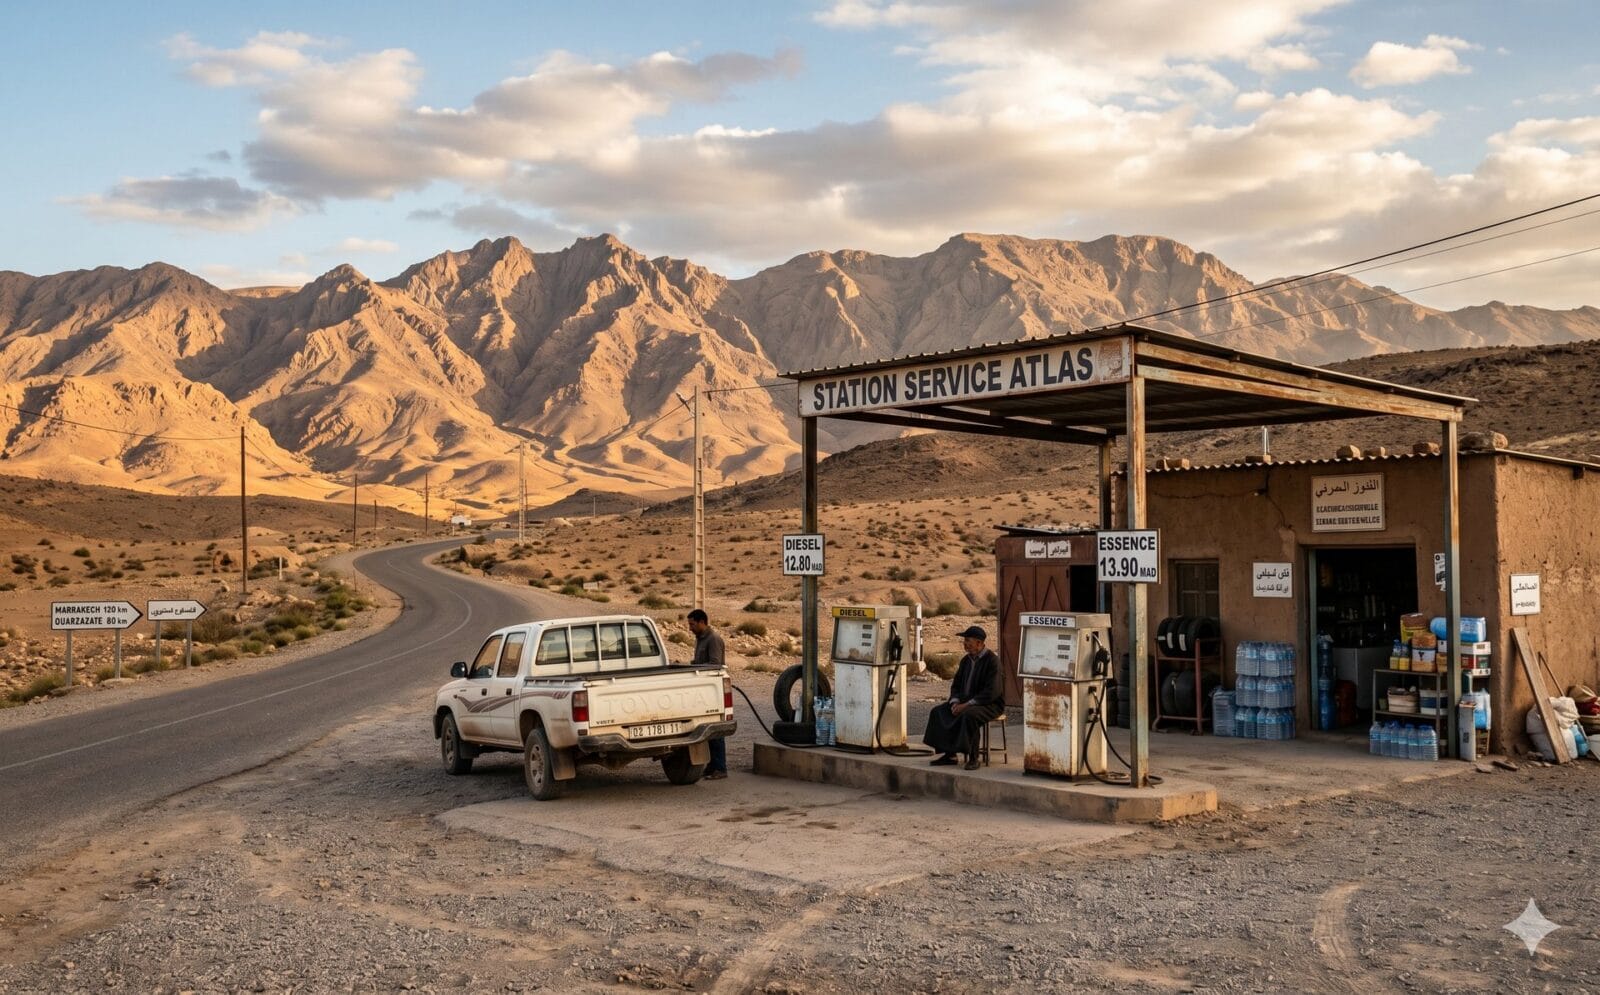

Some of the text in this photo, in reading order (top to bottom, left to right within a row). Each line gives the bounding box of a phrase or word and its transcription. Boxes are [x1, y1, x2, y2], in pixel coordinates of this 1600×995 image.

[813, 347, 1093, 411] STATION SERVICE ATLAS
[786, 539, 820, 550] DIESEL
[1099, 536, 1155, 551] ESSENCE
[785, 555, 822, 571] 12.80 MAD
[1100, 557, 1156, 577] 13.90 MAD
[55, 606, 128, 614] MARRAKECH 120 km
[840, 609, 867, 617] DIESEL
[55, 617, 128, 625] OUARZAZATE 80 km
[1028, 616, 1067, 626] ESSENCE
